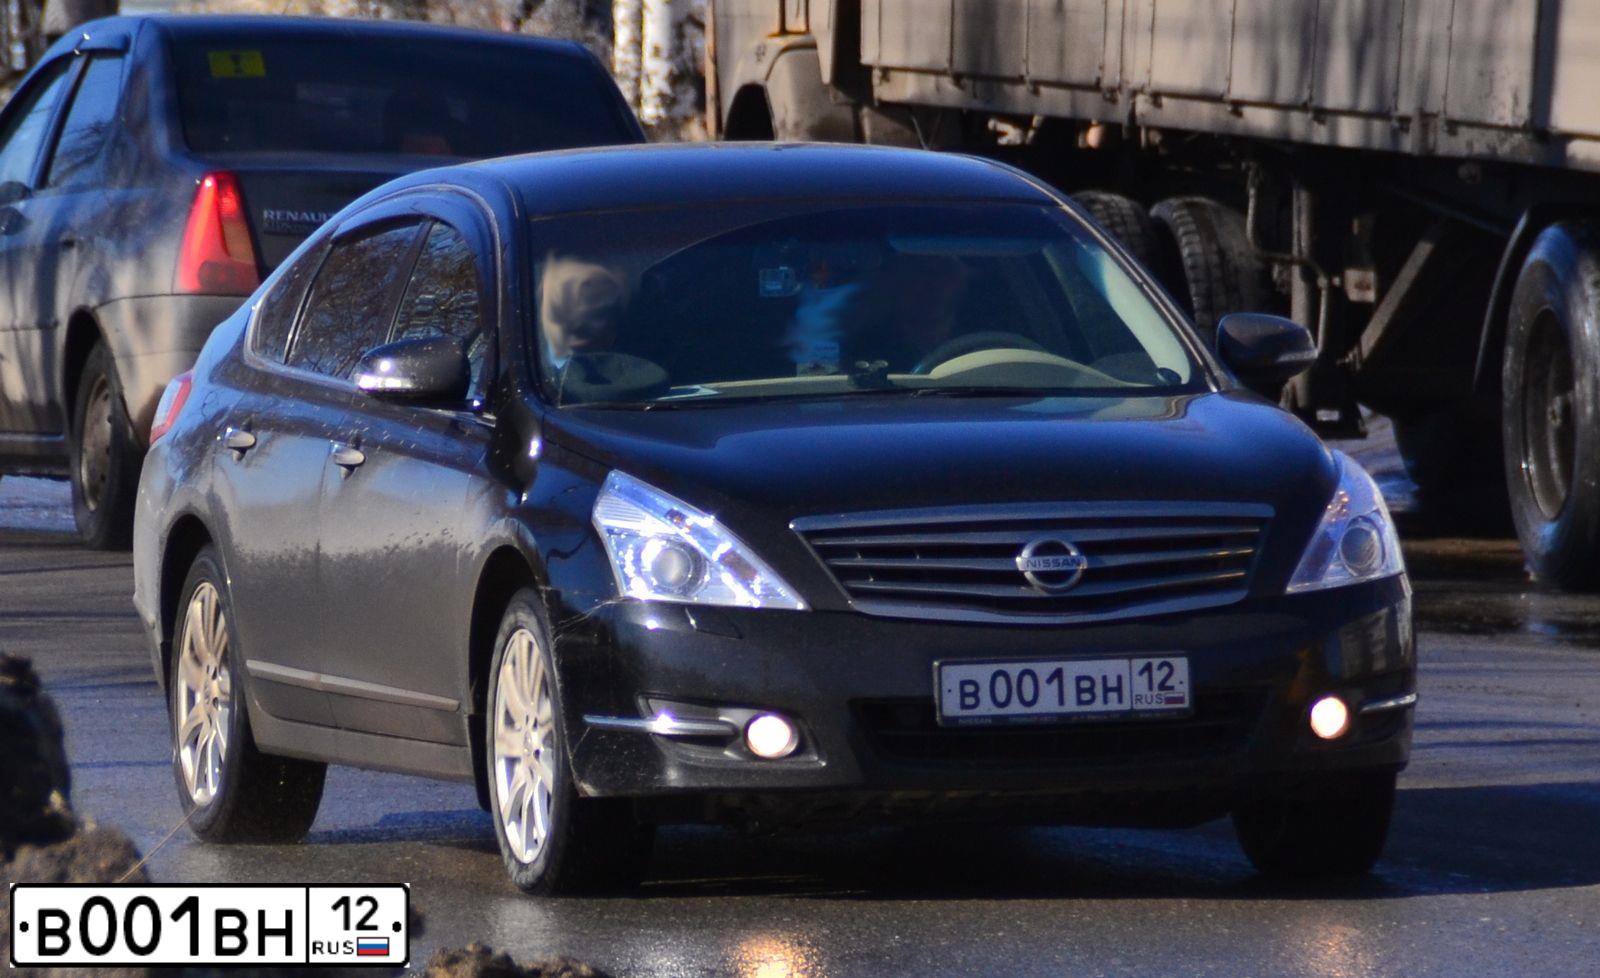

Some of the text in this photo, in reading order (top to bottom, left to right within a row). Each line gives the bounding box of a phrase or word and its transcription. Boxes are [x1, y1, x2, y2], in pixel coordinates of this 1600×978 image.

[1026, 558, 1080, 568] NISSAN
[1138, 660, 1175, 692] 12
[1135, 692, 1164, 705] RUS
